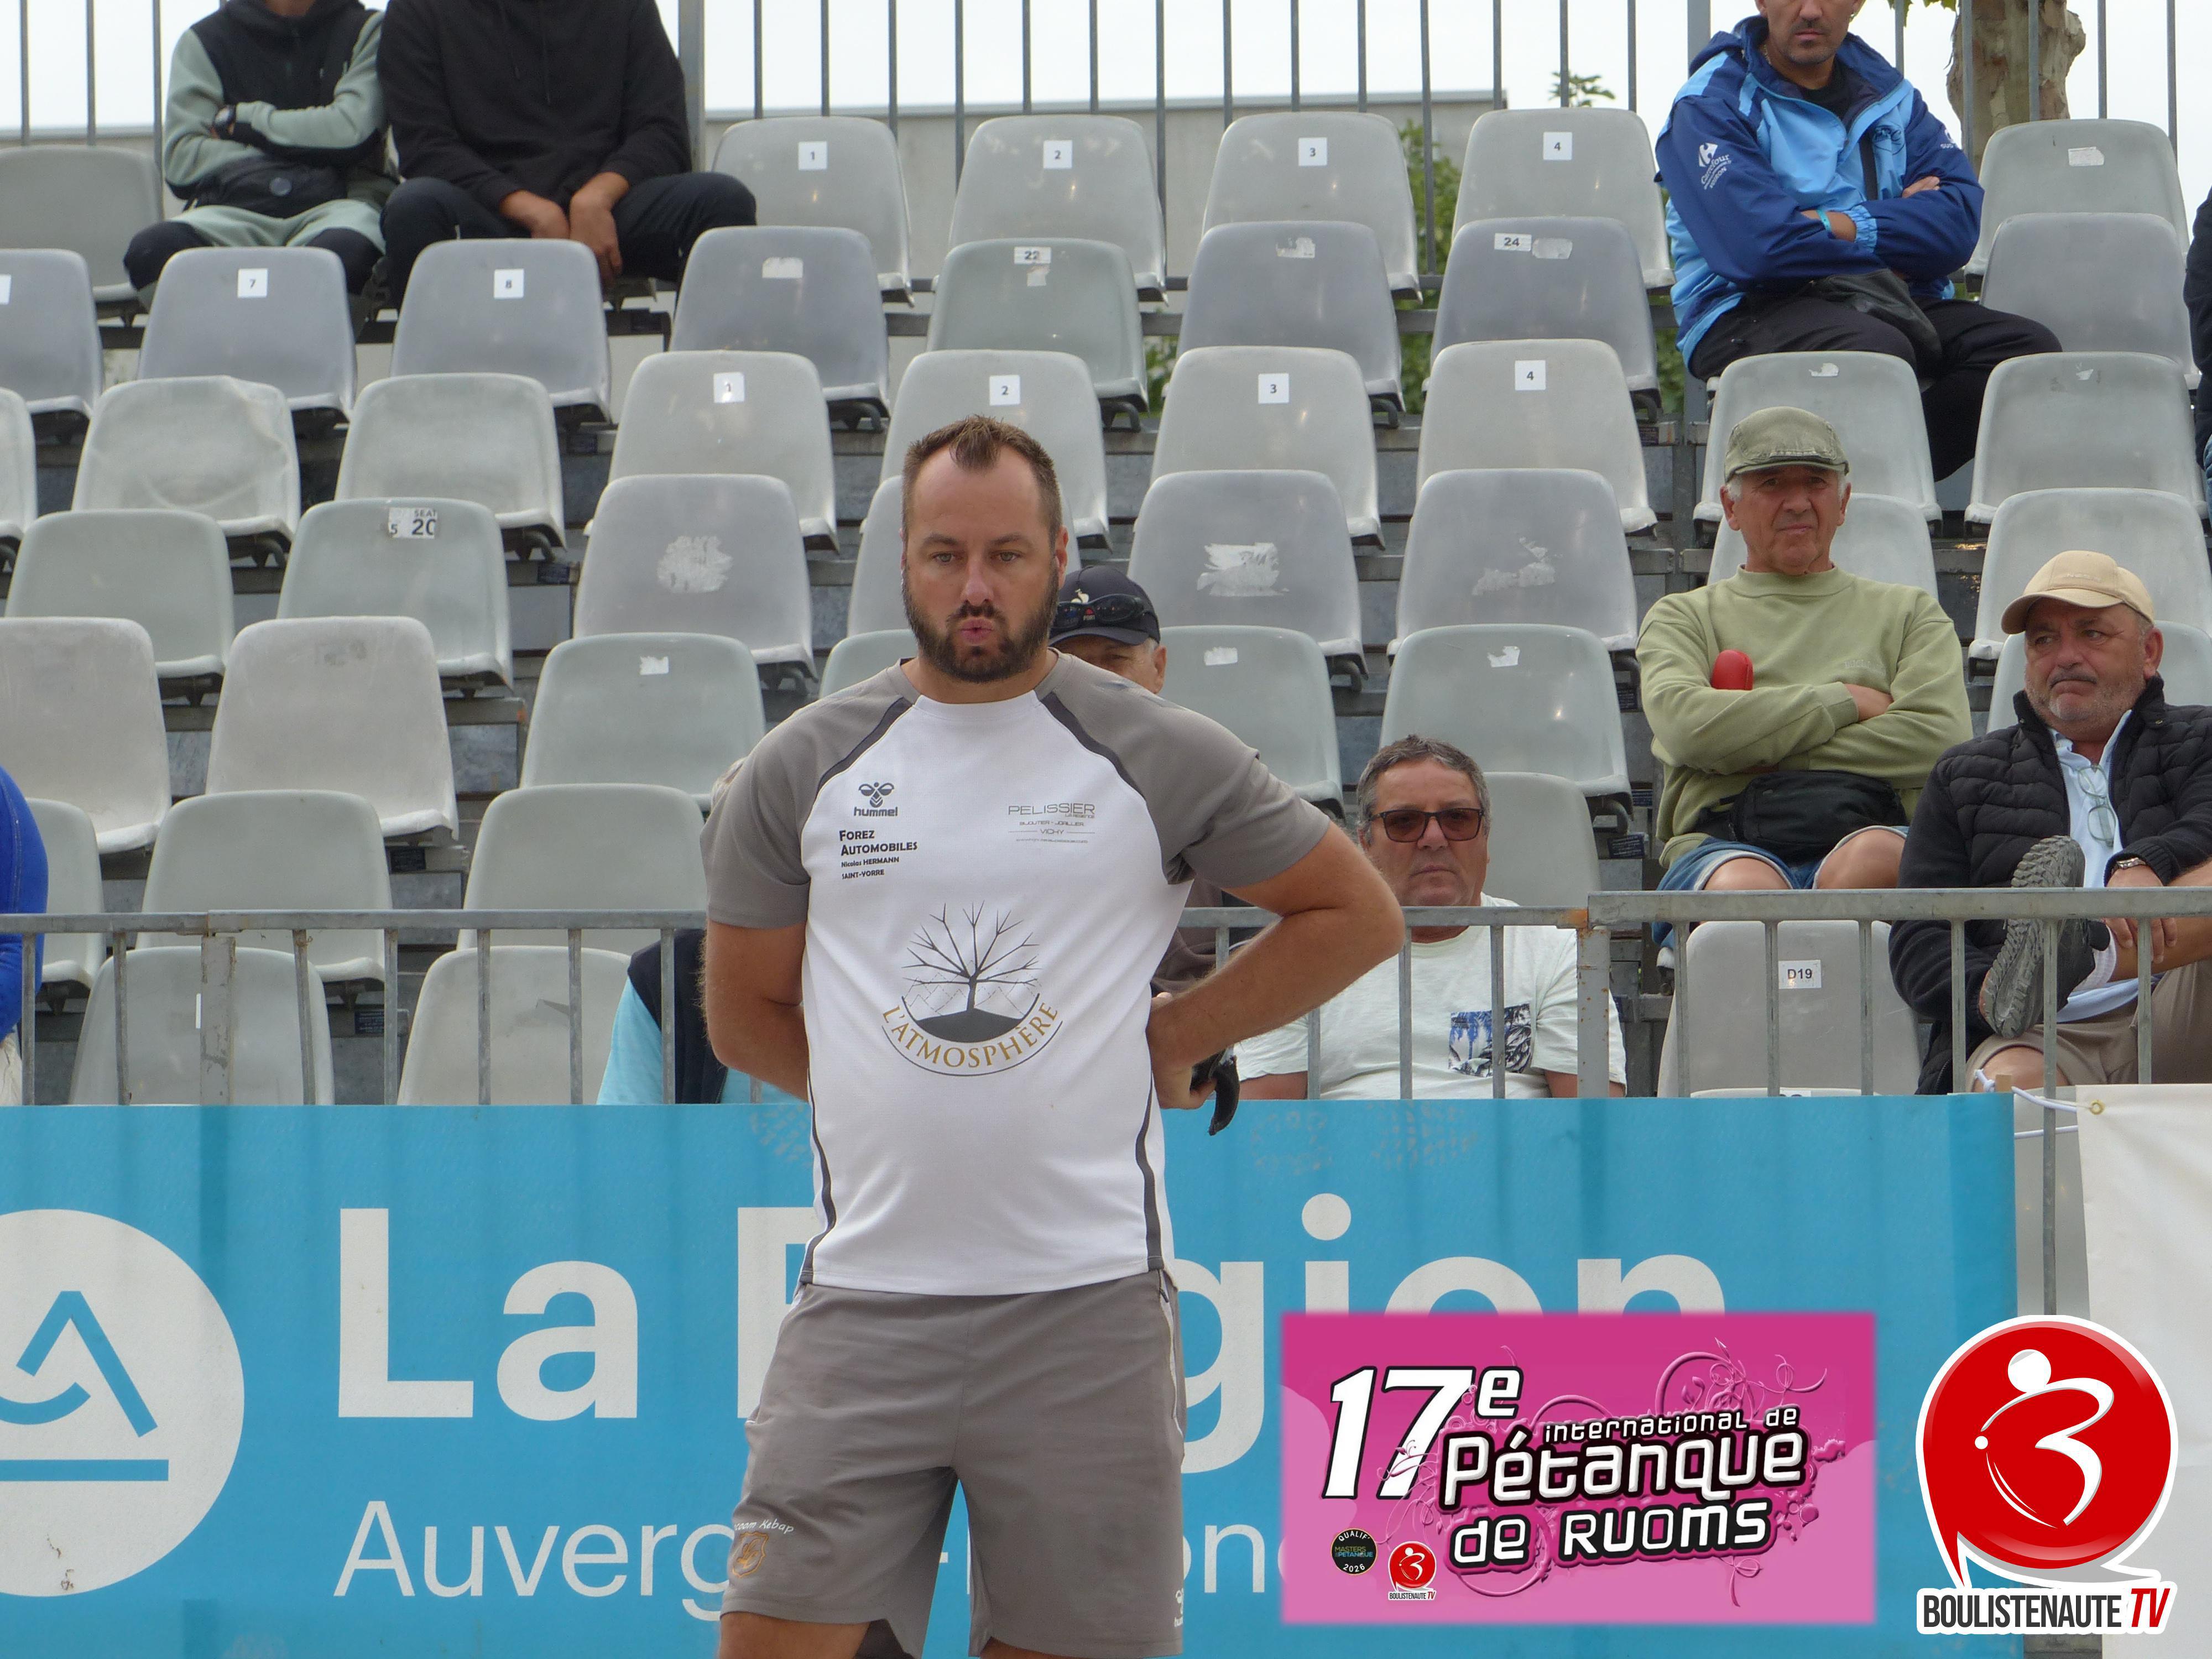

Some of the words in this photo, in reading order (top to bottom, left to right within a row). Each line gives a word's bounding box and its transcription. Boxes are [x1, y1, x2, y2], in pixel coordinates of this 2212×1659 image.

[1554, 142, 1561, 151] 4
[811, 152, 815, 160] 1
[1055, 150, 1061, 159] 2
[1310, 148, 1316, 157] 3
[1504, 237, 1520, 247] 24
[250, 279, 257, 288] 7
[505, 280, 512, 289] 8
[1526, 371, 1534, 380] 4
[1002, 386, 1009, 395] 2
[1270, 384, 1277, 394] 3
[853, 806, 898, 817] hummel
[1008, 802, 1095, 815] PELISSIER
[839, 830, 875, 841] FOREZ
[841, 842, 918, 857] AUTOMOBILES
[863, 857, 899, 865] HERMANN
[842, 869, 885, 880] SAINT-YORRE
[1787, 968, 1813, 979] D19
[338, 1208, 638, 1421] La
